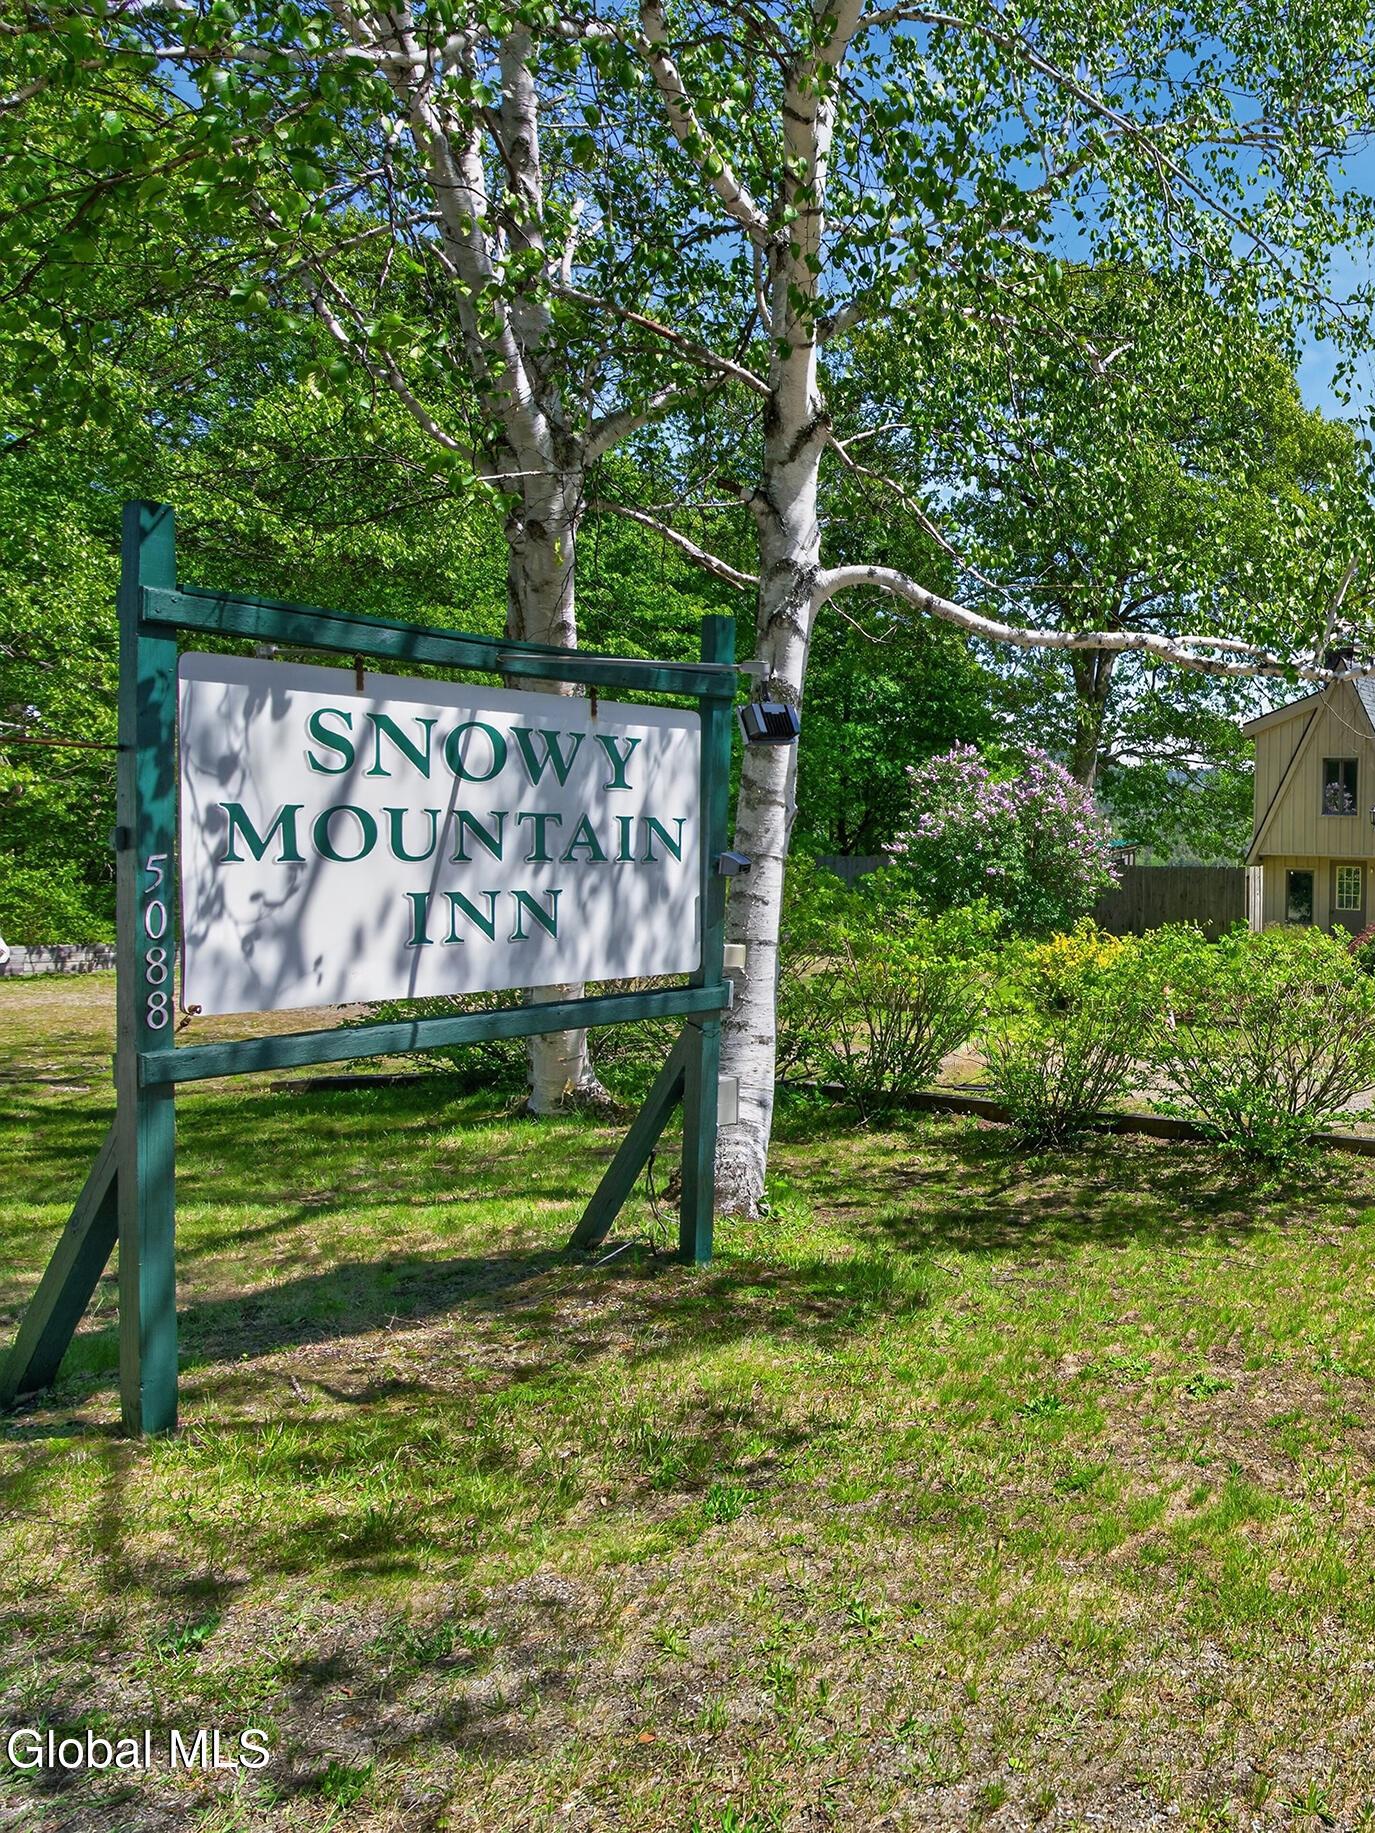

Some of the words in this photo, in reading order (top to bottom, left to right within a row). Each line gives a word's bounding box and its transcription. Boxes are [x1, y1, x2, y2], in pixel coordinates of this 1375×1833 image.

[304, 707, 642, 791] SNOWY
[218, 802, 688, 864] MOUNTAIN
[143, 853, 169, 1031] 5088
[402, 888, 563, 947] INN
